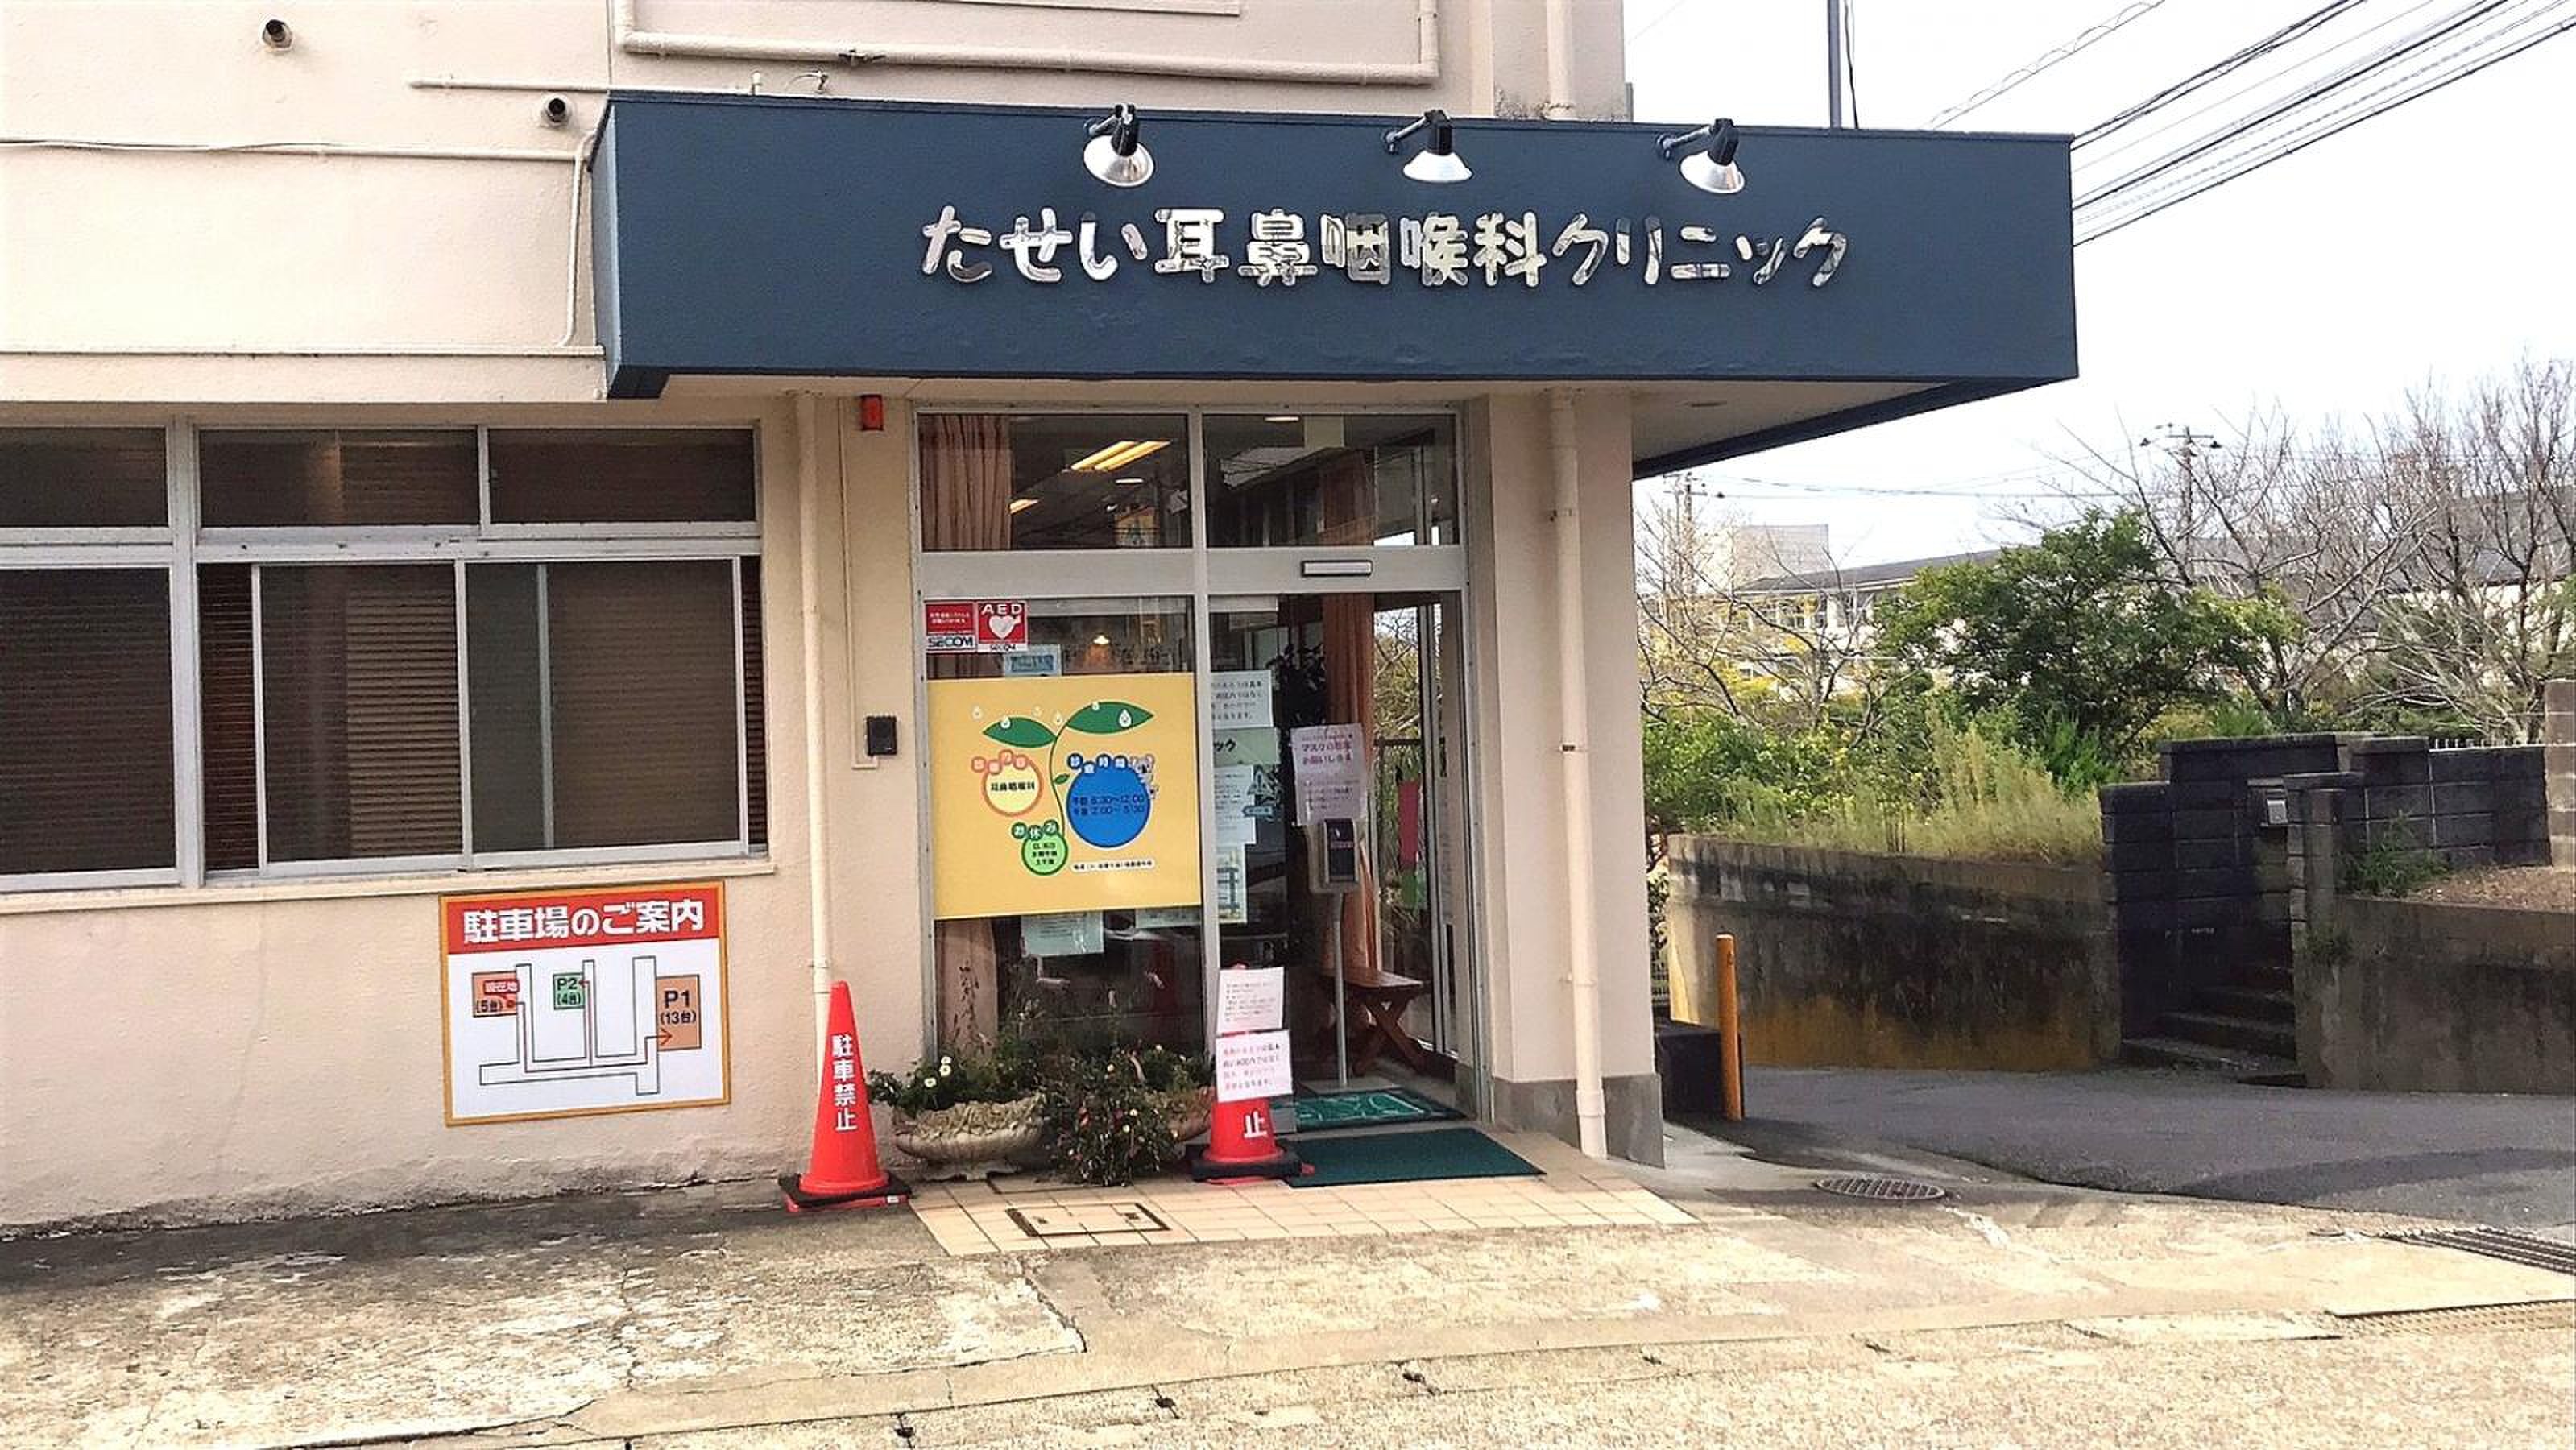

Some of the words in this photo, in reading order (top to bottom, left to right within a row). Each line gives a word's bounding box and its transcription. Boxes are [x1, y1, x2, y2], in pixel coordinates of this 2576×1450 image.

[921, 206, 1851, 287] たせい耳鼻咽喉科クリニック
[981, 604, 1023, 615] AED
[927, 634, 974, 648] SECOM
[462, 898, 705, 944] 駐車場のご案内
[557, 979, 578, 991] P2
[664, 990, 691, 1009] P1
[660, 1012, 698, 1025] (13台)
[831, 1034, 858, 1132] 駐車禁止
[1243, 1110, 1269, 1139] 止
